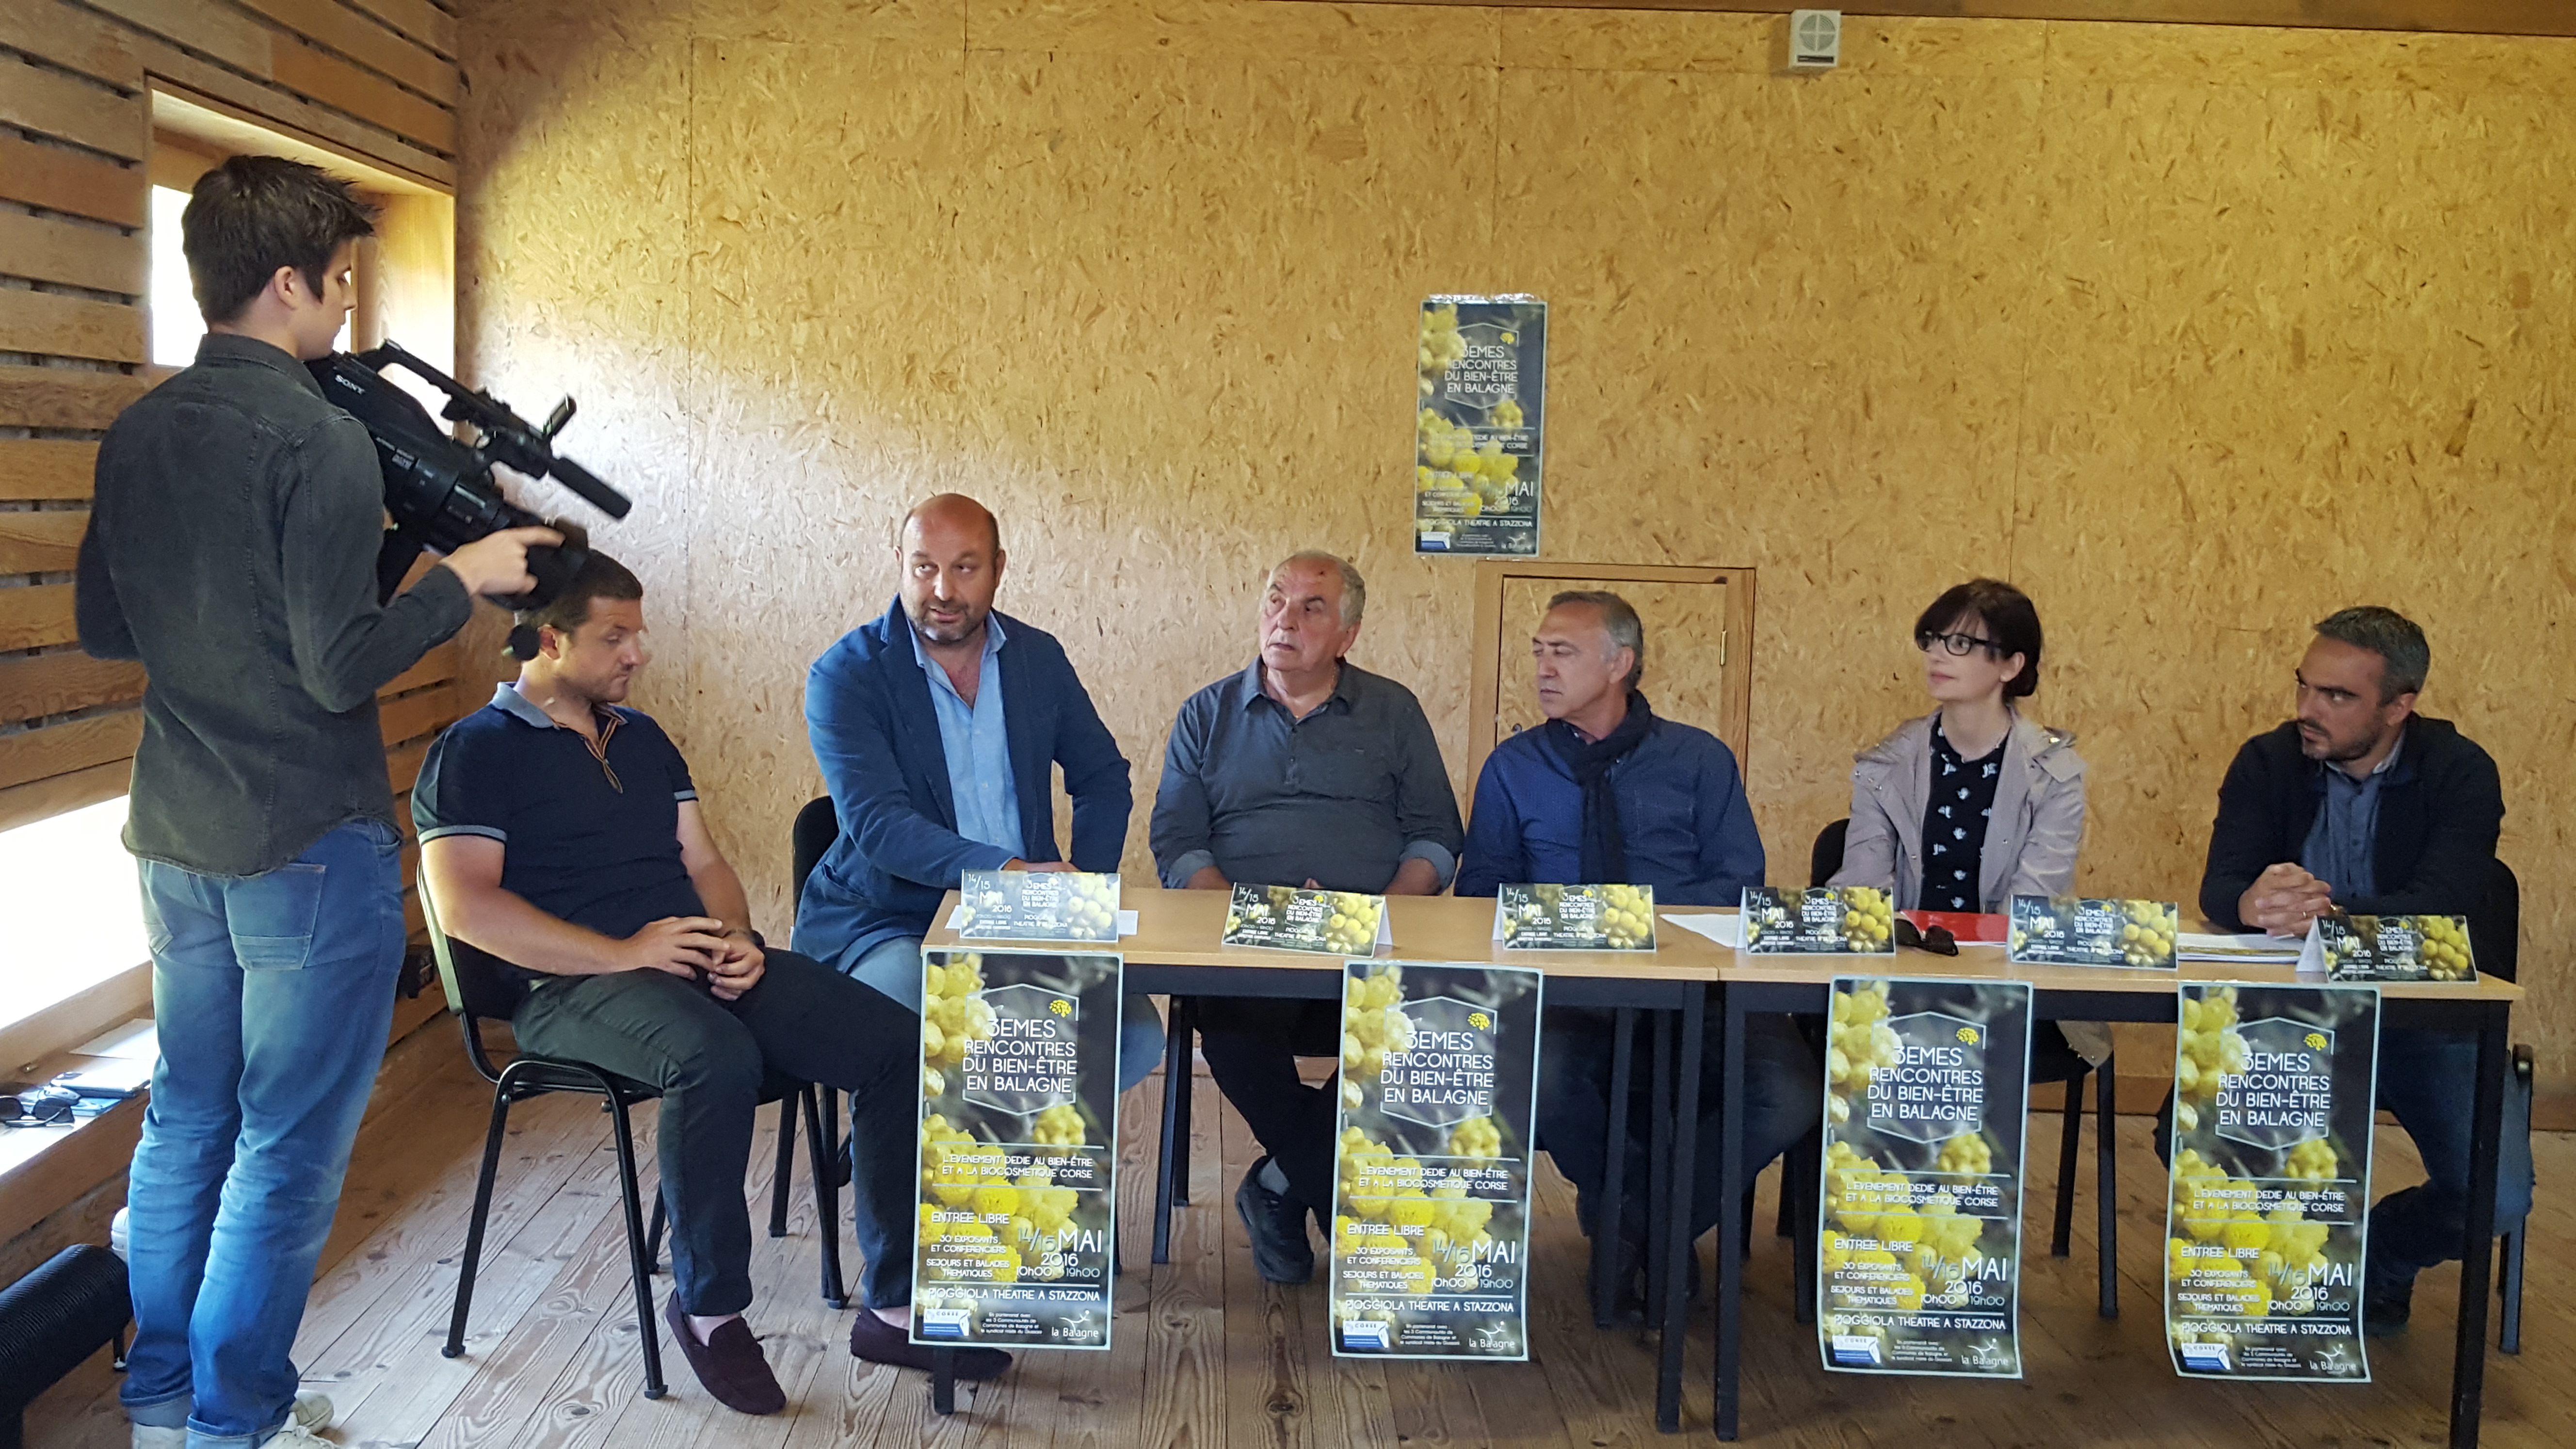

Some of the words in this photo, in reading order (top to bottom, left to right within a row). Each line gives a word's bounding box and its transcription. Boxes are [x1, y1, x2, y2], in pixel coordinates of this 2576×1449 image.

[1445, 371, 1460, 381] DU
[1464, 370, 1518, 382] BIEN-ÊTRE
[335, 375, 365, 395] SONY
[1448, 383, 1461, 392] EN
[1465, 384, 1514, 393] BALAGNE
[1506, 481, 1533, 496] MAI
[979, 891, 1002, 904] MAI
[1246, 904, 1268, 916] MAI
[1519, 904, 1541, 917] MAI
[1762, 908, 1783, 920] MAI
[2030, 917, 2054, 930] MAI
[2337, 937, 2359, 949] MAI
[987, 1018, 1056, 1037] 3EMES
[1406, 1031, 1473, 1050] 3EMES
[964, 1040, 1075, 1056] RENCONTRES
[962, 1058, 985, 1072] DU
[993, 1056, 1077, 1075] BIEN-ÊTRE
[1382, 1053, 1492, 1069] RENCONTRES
[1381, 1070, 1403, 1084] DU
[1411, 1069, 1494, 1087] BIEN-ÊTRE
[1869, 1068, 1982, 1084] RENCONTRES
[2217, 1074, 2329, 1090] RENCONTRES
[966, 1076, 987, 1091] EN
[995, 1077, 1072, 1093] BALAGNE
[1385, 1088, 1404, 1103] EN
[1412, 1089, 1488, 1105] BALAGNE
[1868, 1085, 1891, 1100] DU
[1898, 1084, 1983, 1103] BIEN-ÊTRE
[2216, 1092, 2239, 1107] DU
[2246, 1090, 2330, 1109] BIEN-ÊTRE
[1871, 1103, 1892, 1118] EN
[1900, 1105, 1978, 1120] BALAGNE
[2220, 1111, 2240, 1125] EN
[2248, 1111, 2325, 1127] BALAGNE
[1048, 1154, 1093, 1166] BIEN-ÊTRE
[1060, 1169, 1093, 1178] CORSE
[1464, 1166, 1508, 1178] BIEN-ÊTRE
[1475, 1181, 1507, 1190] CORSE
[1965, 1197, 1997, 1207] CORSE
[2312, 1204, 2344, 1212] CORSE
[932, 1212, 974, 1223] ENTREE
[979, 1213, 1010, 1224] LIBRE
[1348, 1224, 1390, 1235] ENTREE
[1394, 1225, 1424, 1236] LIBRE
[1058, 1229, 1102, 1252] MAI
[1834, 1239, 1877, 1250] ENTREE
[1882, 1241, 1913, 1252] LIBRE
[1473, 1240, 1515, 1264] MAI
[2181, 1247, 2224, 1257] ENTREE
[2229, 1248, 2259, 1258] LIBRE
[1041, 1254, 1078, 1266] 2016
[1017, 1267, 1052, 1277] 10h00
[1066, 1268, 1100, 1277] 19h00
[1455, 1265, 1492, 1277] 2016
[1963, 1256, 2007, 1280] MAI
[2308, 1262, 2352, 1286] MAI
[1432, 1279, 1466, 1288] 10h00
[1481, 1279, 1513, 1288] 19h00
[1945, 1282, 1982, 1294] 2016
[928, 1289, 988, 1299] PIOGGIOLA
[993, 1290, 1035, 1300] THEATRE
[1038, 1291, 1045, 1300] A
[1049, 1292, 1100, 1301] STAZZONA
[2291, 1288, 2328, 1300] 2016
[1346, 1301, 1405, 1311] PIOGGIOLA
[1409, 1301, 1450, 1311] THEATRE
[1453, 1303, 1460, 1311] A
[1464, 1303, 1513, 1312] STAZZONA
[1900, 1316, 1939, 1327] THEATRE
[1944, 1319, 1951, 1328] A
[1955, 1319, 2006, 1330] STAZZONA
[2247, 1323, 2286, 1334] THEATRE
[2291, 1325, 2297, 1334] A
[2301, 1325, 2351, 1335] STAZZONA
[1051, 1327, 1058, 1337] la
[1063, 1328, 1098, 1338] Balagne
[1469, 1338, 1476, 1348] la
[1480, 1339, 1515, 1350] Balagne
